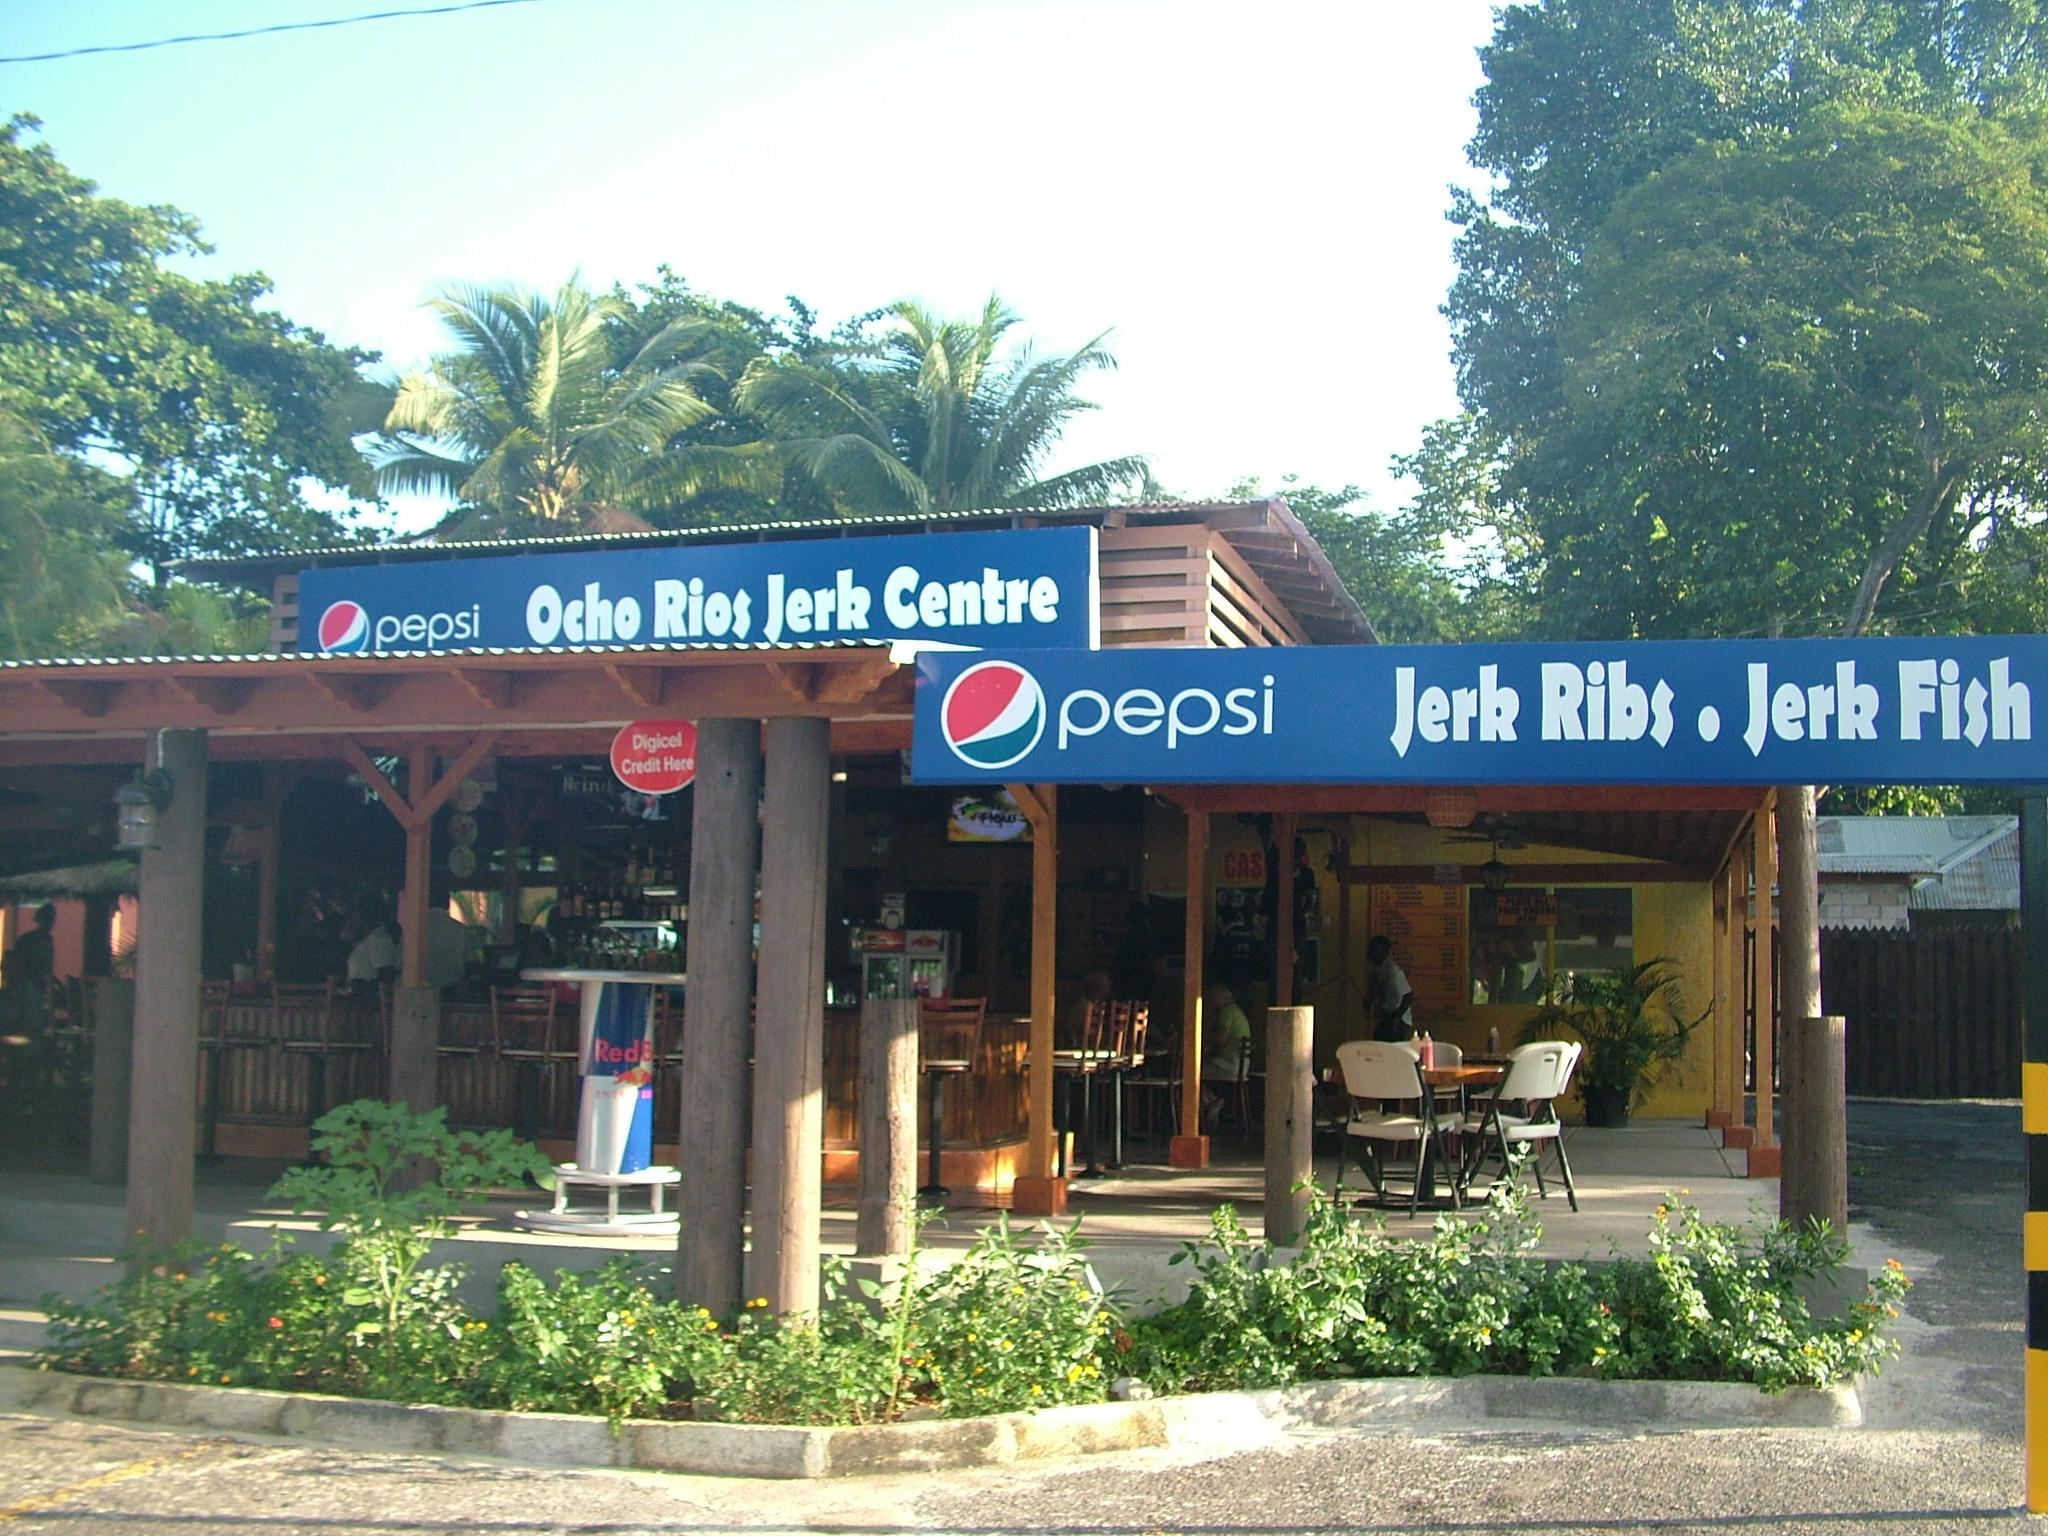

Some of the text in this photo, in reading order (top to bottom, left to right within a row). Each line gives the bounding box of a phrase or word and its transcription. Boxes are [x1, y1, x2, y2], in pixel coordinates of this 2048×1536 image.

[375, 604, 480, 649] pepsi
[525, 566, 1060, 645] Ocho Rios Jerk Centre
[1058, 674, 1275, 750] pepsi
[1389, 657, 2031, 758] Jerk Ribs Jerk Fish
[621, 756, 694, 775] Credit Here
[632, 732, 683, 753] Digicel
